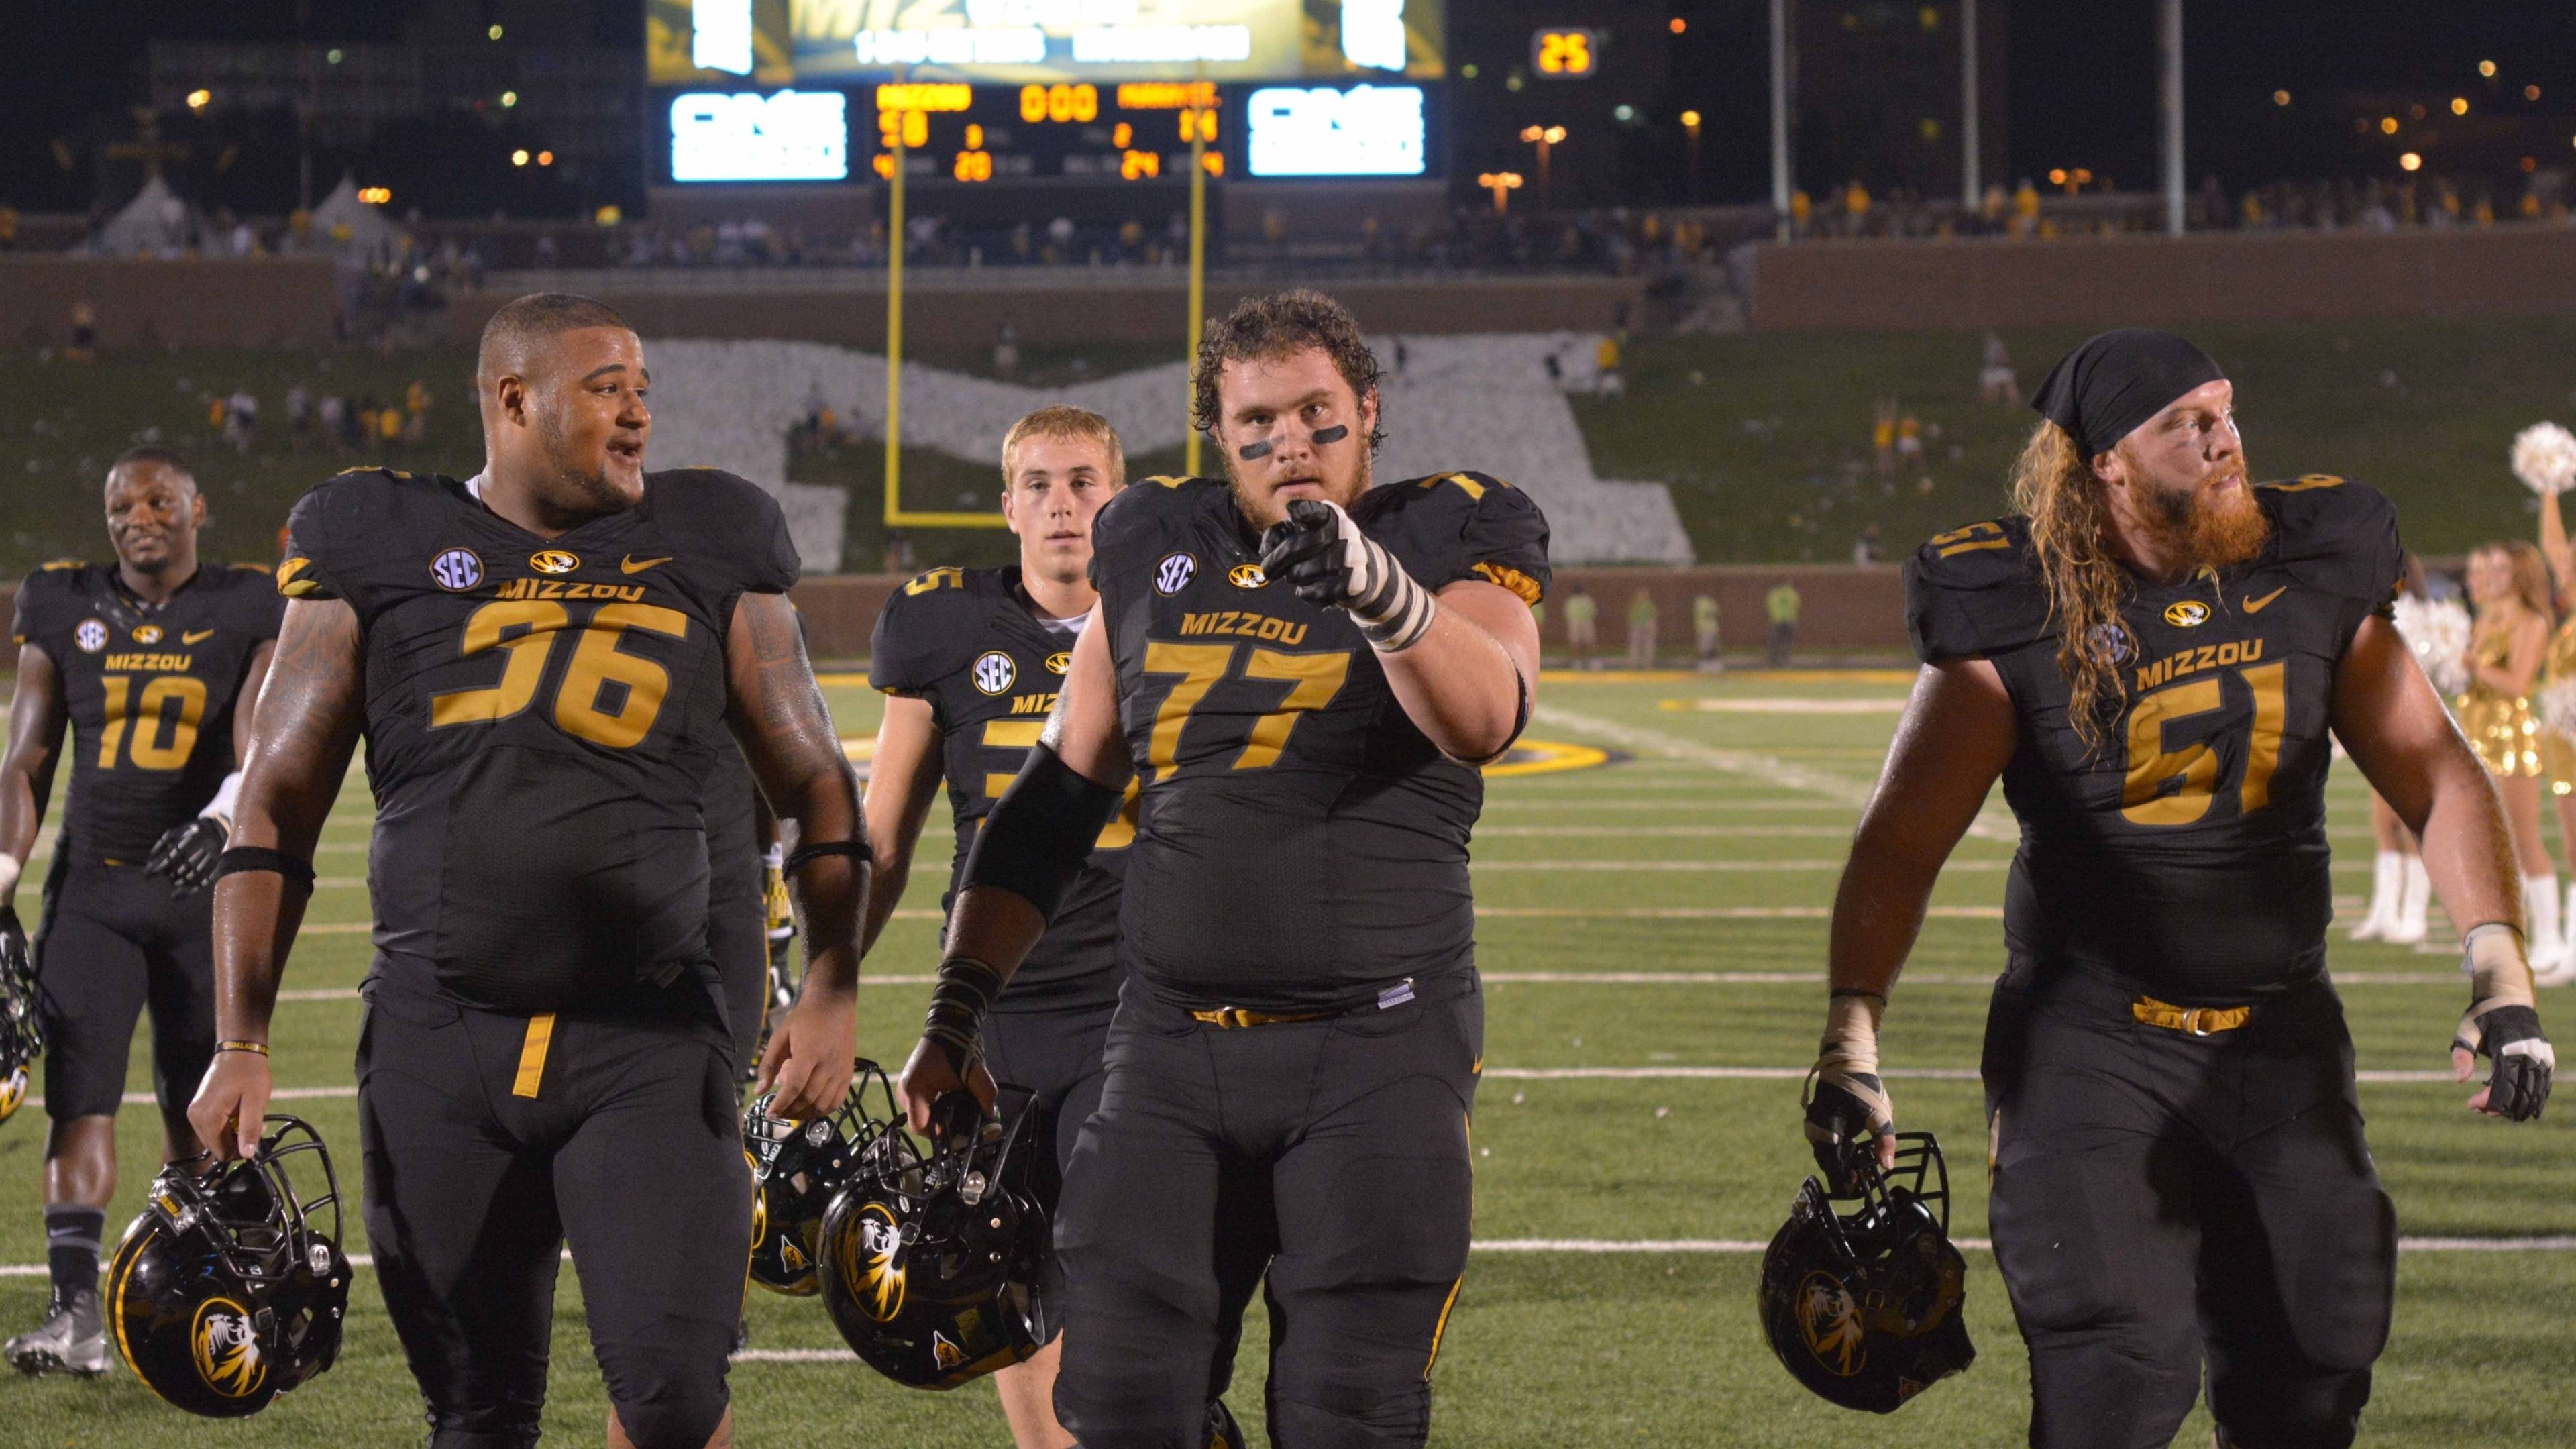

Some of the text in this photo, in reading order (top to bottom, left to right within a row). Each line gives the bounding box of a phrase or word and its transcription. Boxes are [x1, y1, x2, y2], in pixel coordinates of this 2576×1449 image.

[1540, 32, 1589, 73] 25
[433, 551, 479, 588] SEC
[1156, 554, 1195, 594] SEC
[495, 578, 645, 602] MIZZOU
[78, 622, 106, 651] SEC
[1179, 611, 1309, 646] MIZZOU
[105, 654, 192, 670] MIZZOU
[976, 655, 1012, 692] SEC
[2136, 638, 2264, 692] MIZZOU
[1010, 693, 1060, 714] MIZ
[1144, 641, 1352, 782] 77
[98, 675, 207, 770] 10
[2120, 661, 2286, 826] 61
